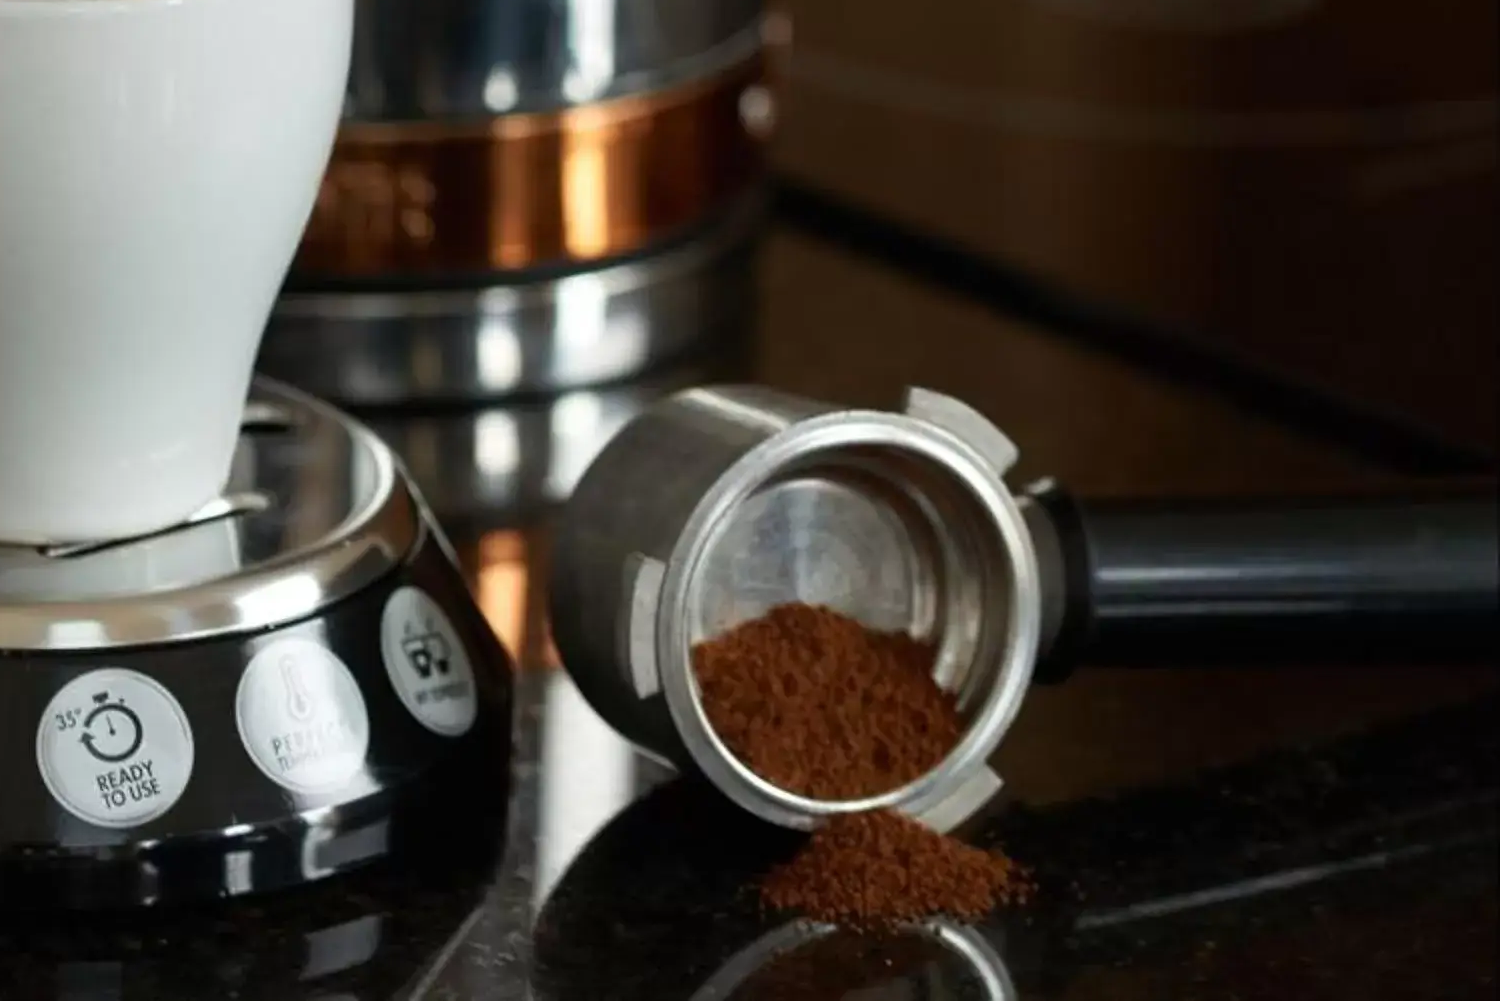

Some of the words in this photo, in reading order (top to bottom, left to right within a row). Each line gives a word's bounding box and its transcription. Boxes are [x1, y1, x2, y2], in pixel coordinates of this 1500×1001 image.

[96, 759, 154, 792] READY
[102, 789, 127, 809] TO
[128, 778, 162, 803] USE
